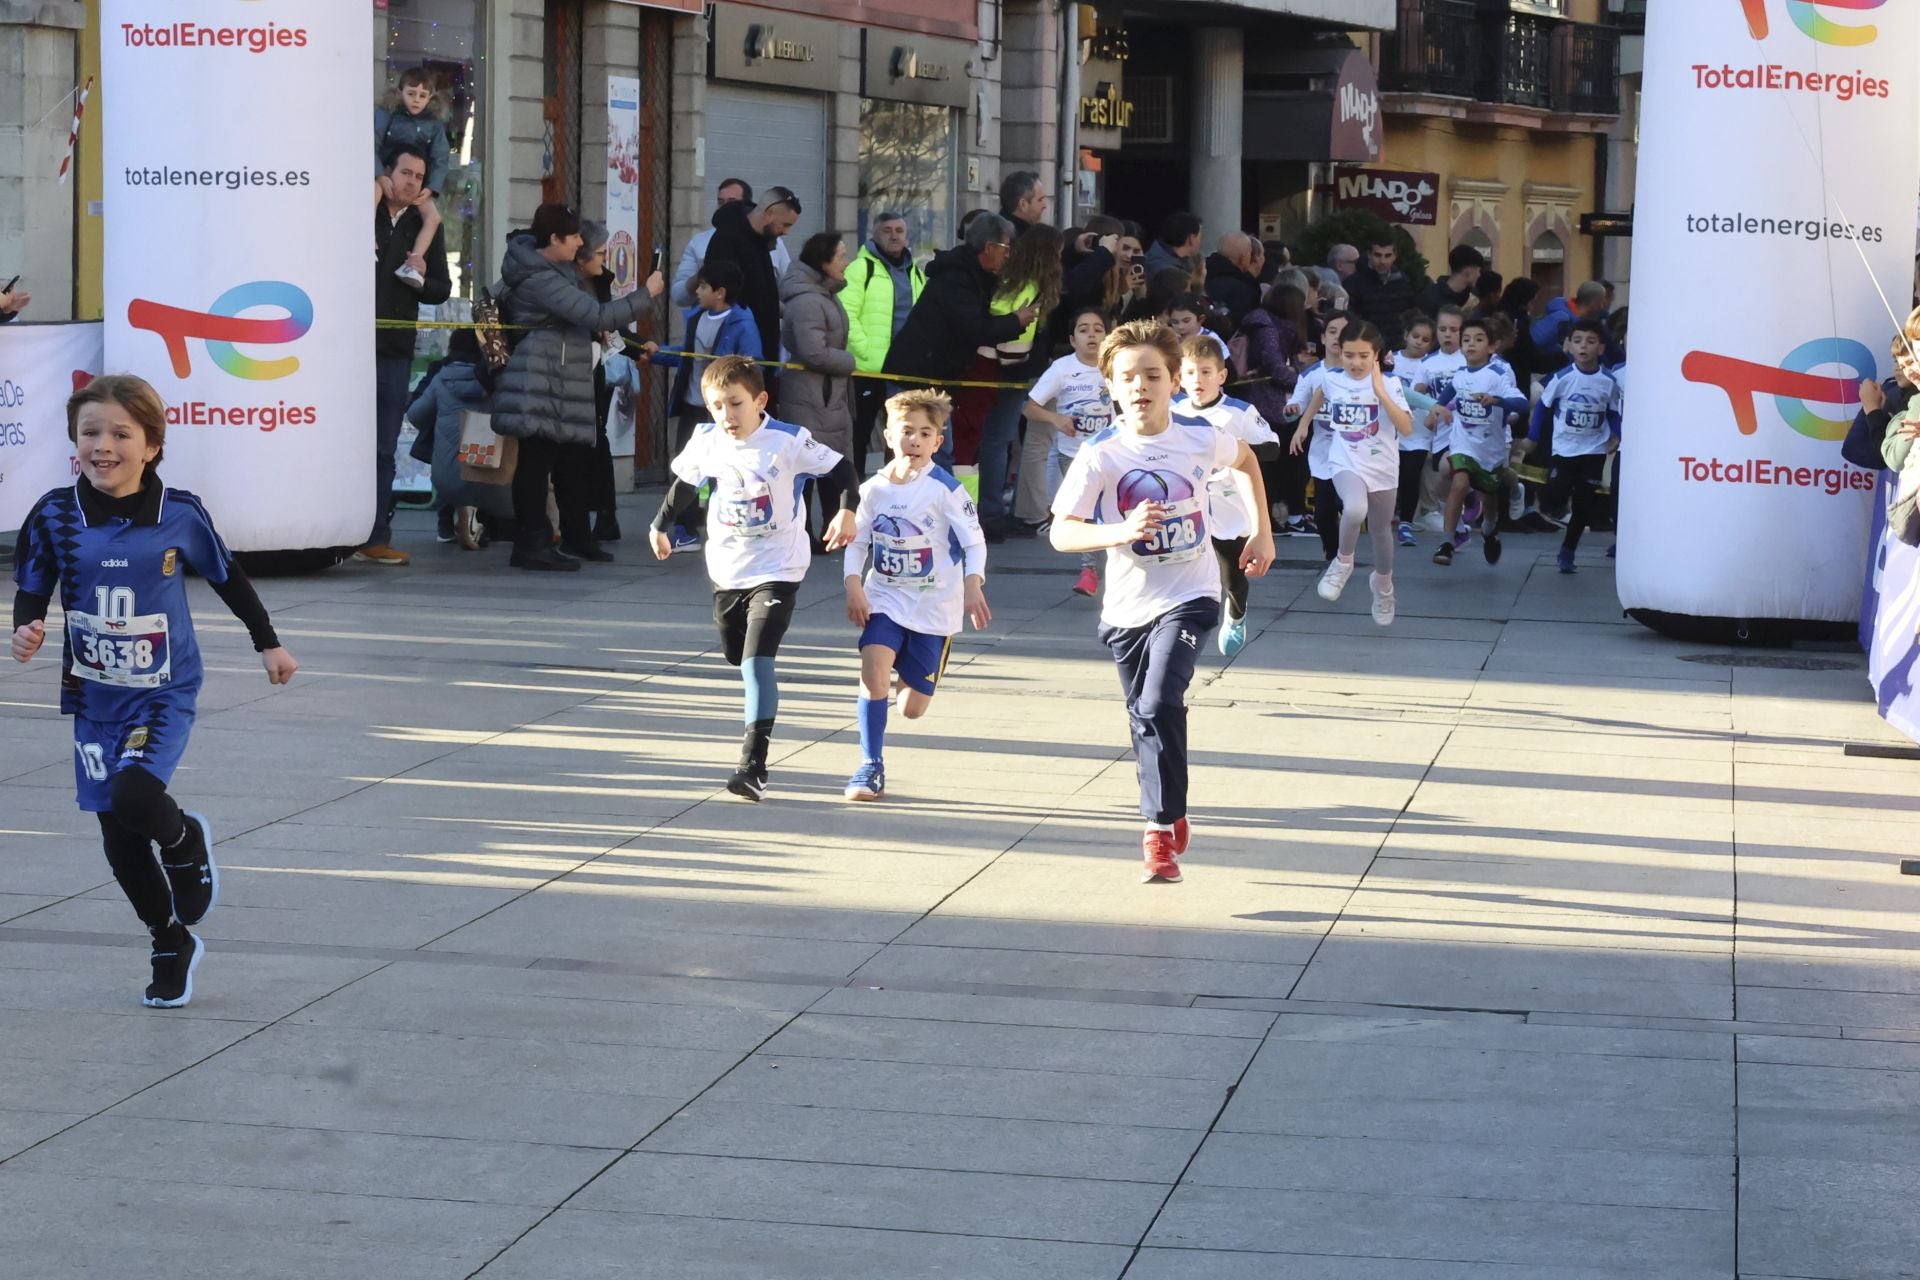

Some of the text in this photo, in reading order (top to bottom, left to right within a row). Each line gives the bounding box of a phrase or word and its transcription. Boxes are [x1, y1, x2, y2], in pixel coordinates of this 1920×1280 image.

[121, 22, 307, 53] TotalEnergies
[1691, 64, 1889, 101] TotalEnergies
[125, 167, 310, 189] totalenergies.es
[1338, 174, 1422, 206] MUNDO
[1687, 213, 1882, 242] totalenergies.es
[1339, 406, 1370, 422] 3341
[1679, 457, 1874, 495] TotalEnergies
[102, 558, 128, 568] adidas
[881, 550, 922, 574] 3315
[95, 586, 135, 617] 10
[82, 635, 153, 669] 3638
